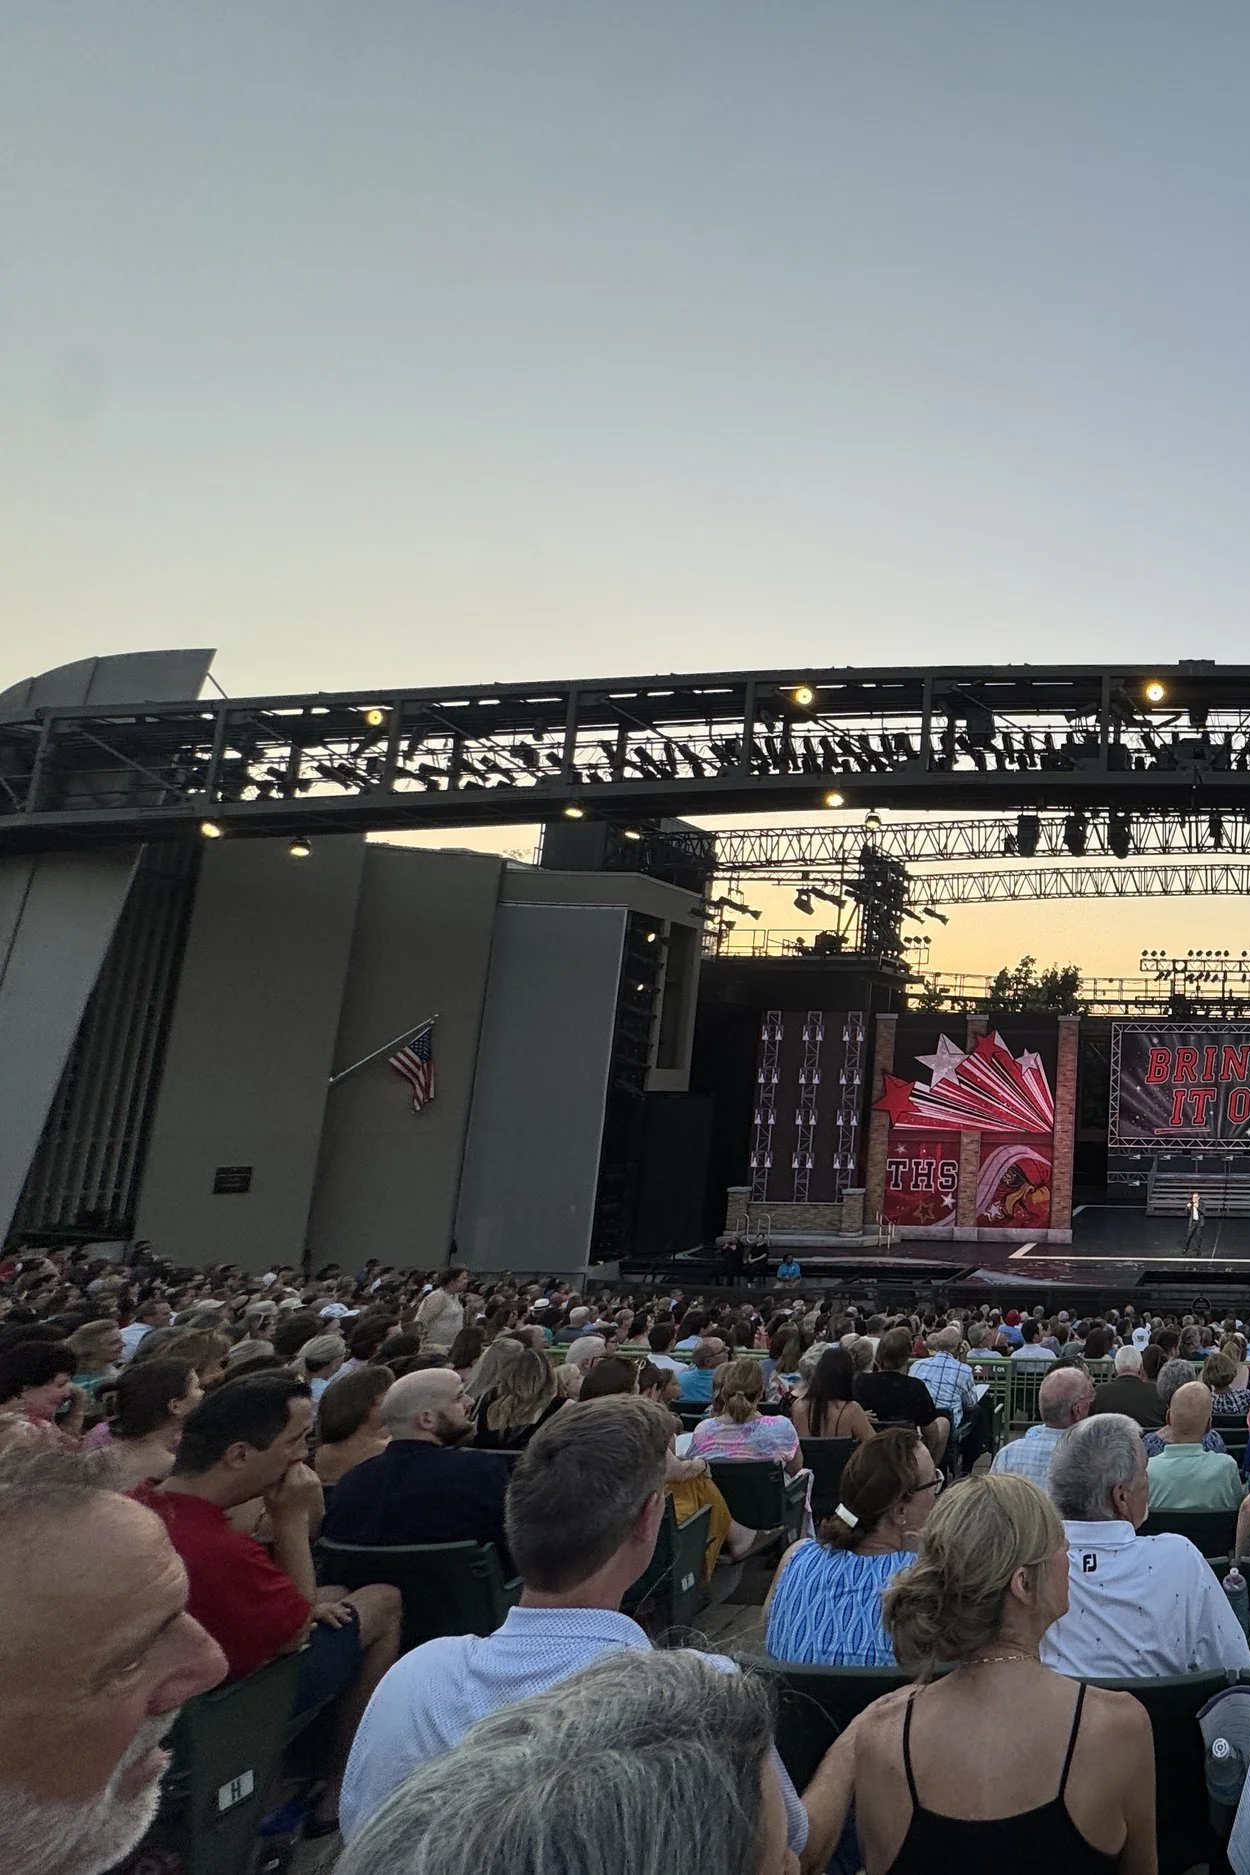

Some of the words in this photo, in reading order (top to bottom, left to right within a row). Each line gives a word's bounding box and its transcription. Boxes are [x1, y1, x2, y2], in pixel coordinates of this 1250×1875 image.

[1169, 1087, 1217, 1126] IT
[886, 1158, 959, 1192] THS
[1083, 1553, 1097, 1572] FJ
[231, 1778, 242, 1801] H
